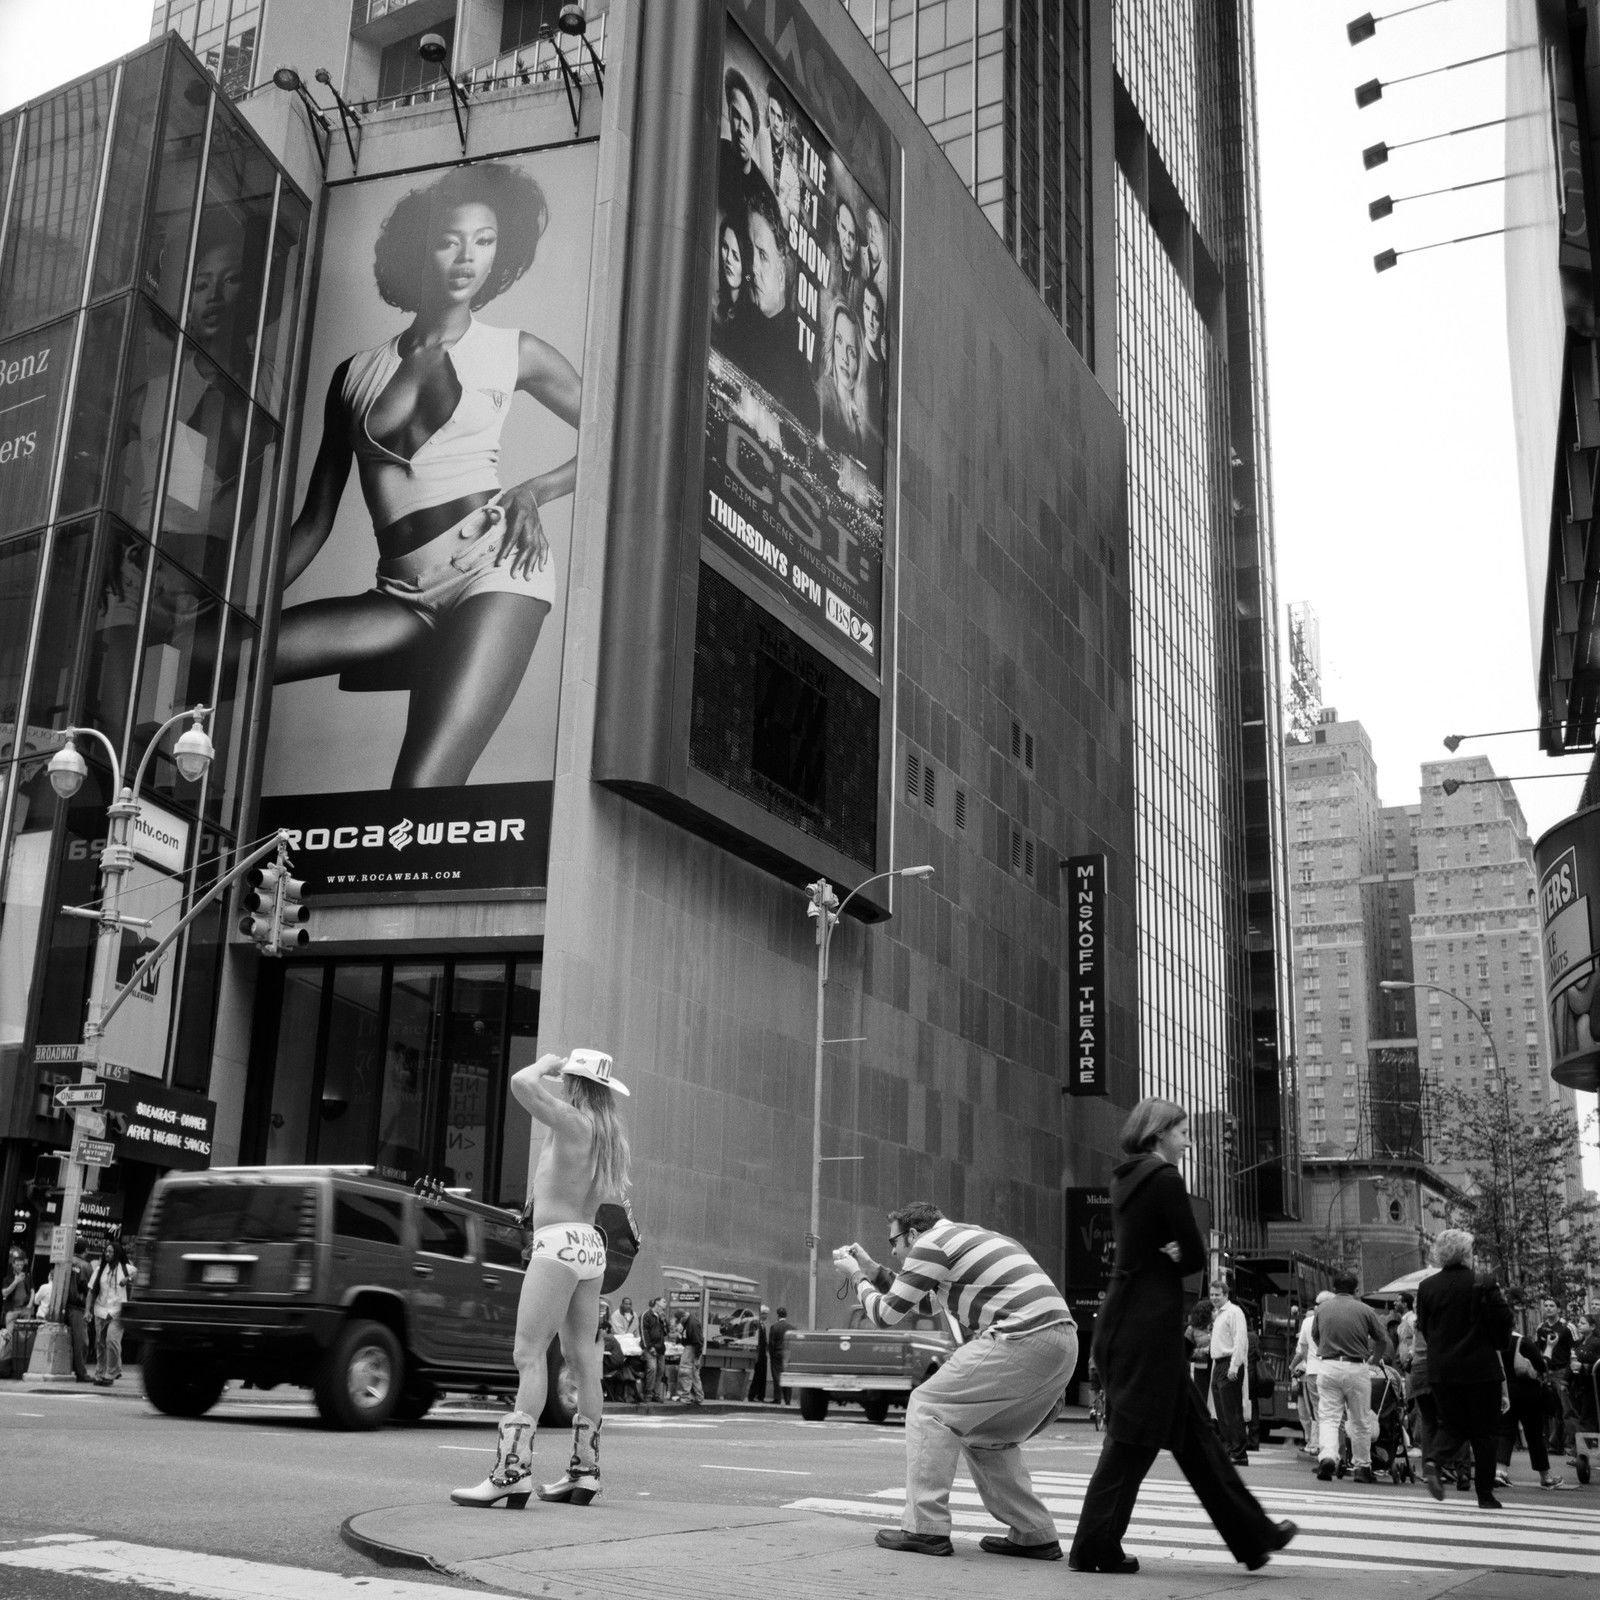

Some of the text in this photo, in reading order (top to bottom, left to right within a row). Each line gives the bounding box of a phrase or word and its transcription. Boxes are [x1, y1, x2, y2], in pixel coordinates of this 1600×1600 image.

[801, 135, 827, 196] THE
[803, 189, 819, 230] #1
[789, 213, 831, 289] SHOW
[798, 271, 819, 322] ON
[797, 316, 816, 364] TV
[709, 489, 789, 577] THURSDAYS
[792, 564, 822, 607] 9PM
[827, 592, 850, 630] CBS
[724, 474, 870, 609] CRIME SCENE INVESTIGATION
[327, 871, 462, 884] WWW.ROCAWEAR.COM
[1077, 865, 1095, 975] MINSKOFF
[35, 1047, 77, 1061] BROADWAY
[1079, 986, 1095, 1084] THEATRE
[61, 1091, 98, 1101] ONE WAY
[113, 1066, 122, 1078] 45
[126, 1124, 151, 1141] AFTER
